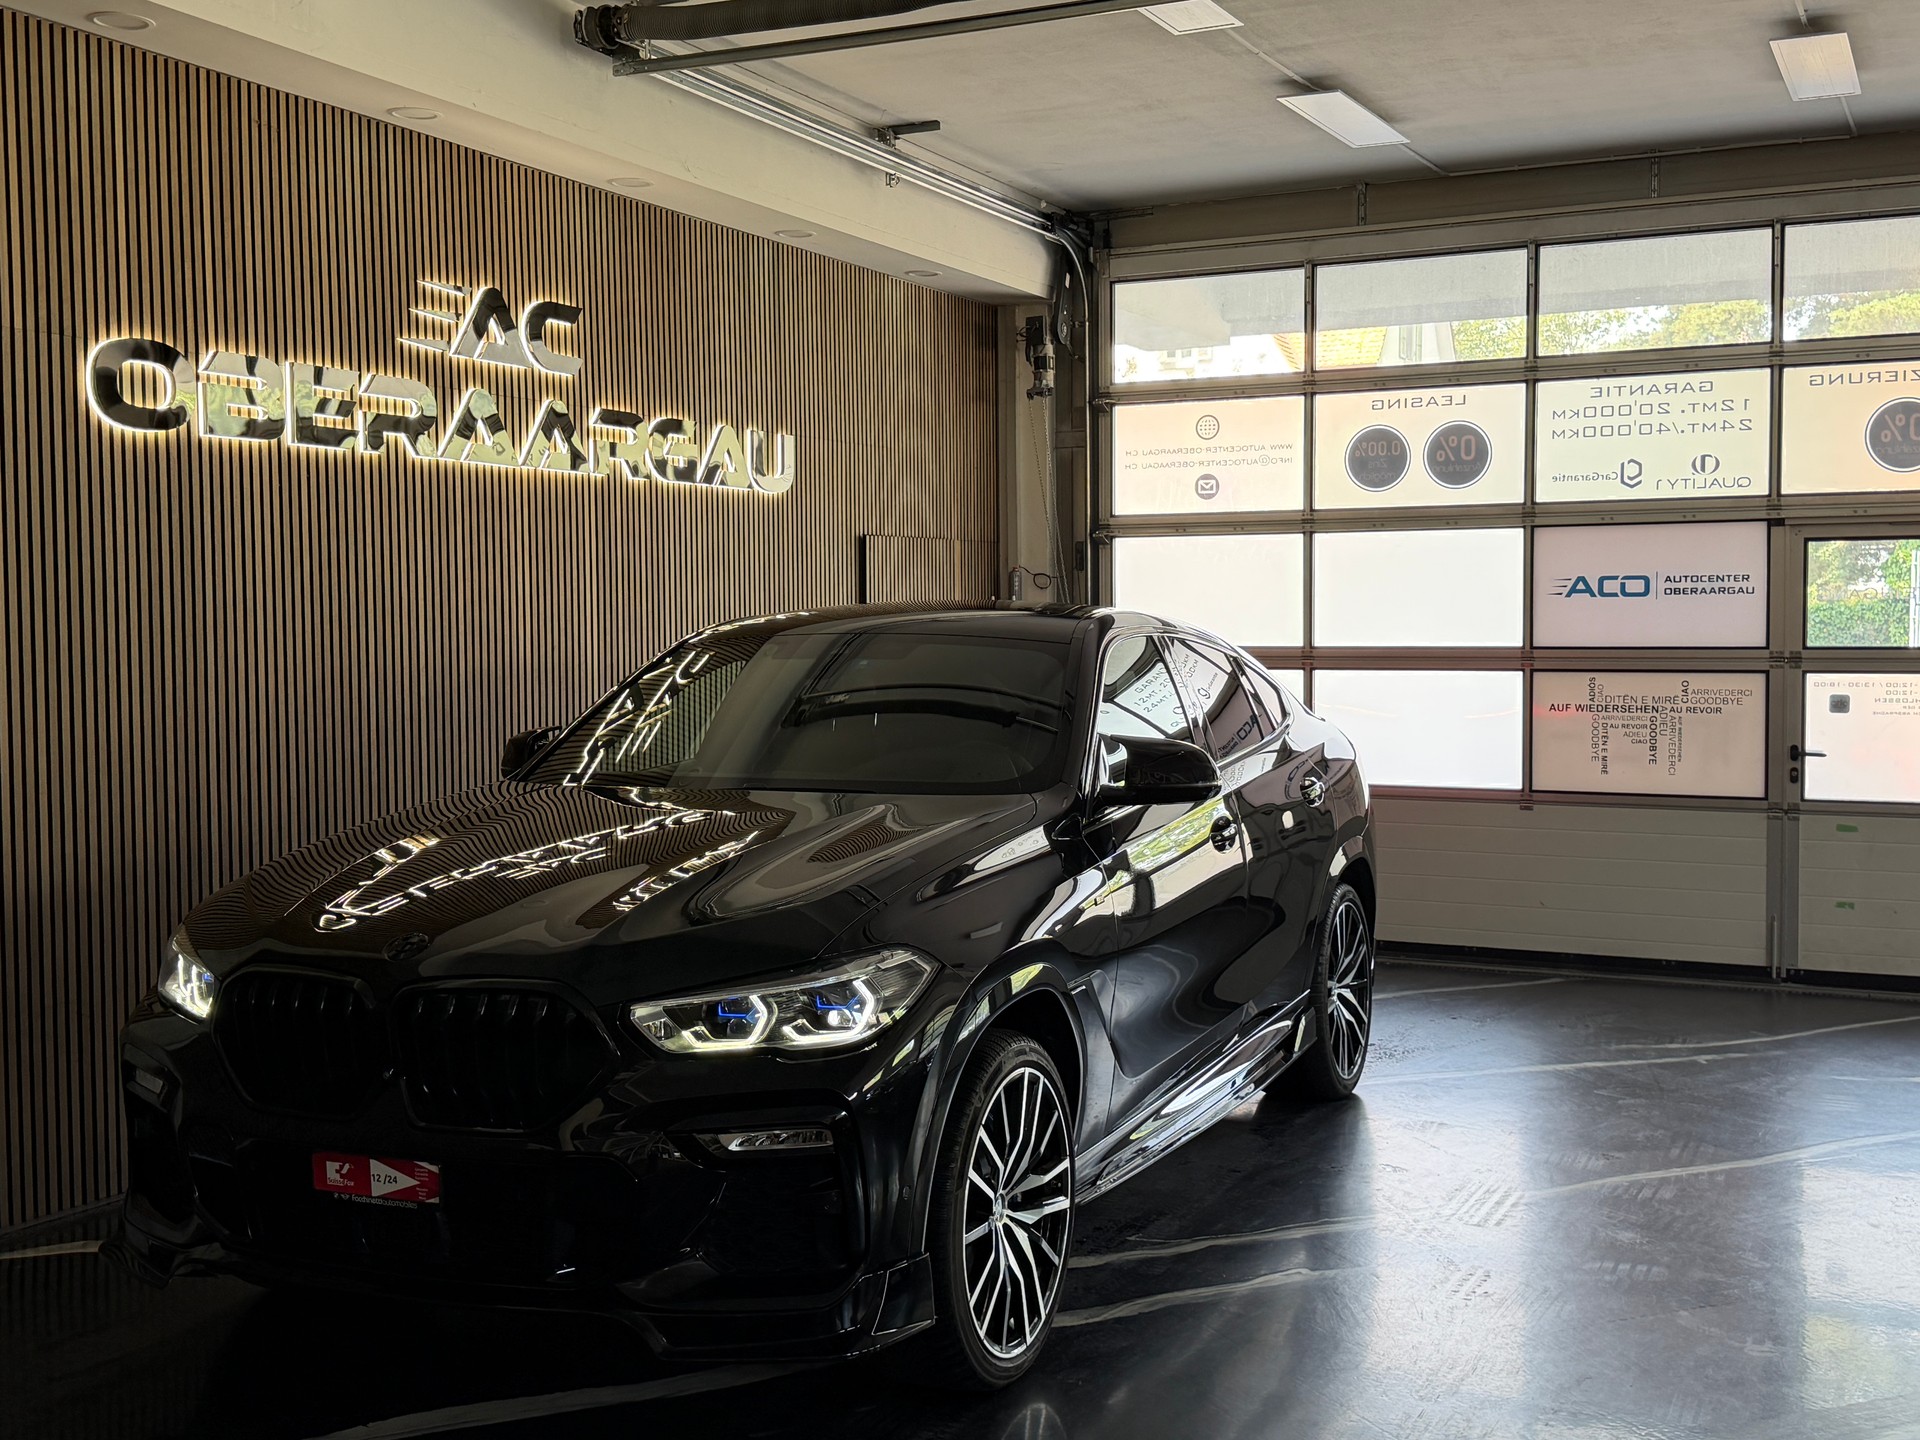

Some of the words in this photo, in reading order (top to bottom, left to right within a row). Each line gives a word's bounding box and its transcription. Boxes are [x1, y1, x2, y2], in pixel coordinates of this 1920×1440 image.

[85, 337, 795, 495] OBERAARGAU
[1663, 573, 1750, 584] AUTOCENTER
[1564, 575, 1650, 598] ACO
[1663, 586, 1755, 596] OBERAARGAU
[1681, 680, 1690, 704] CIAO
[1690, 688, 1753, 697] ARRIVEDERCI
[1690, 697, 1744, 706] GOODBYE
[1549, 703, 1571, 712] AUF
[1574, 703, 1660, 714] WIEDERSEHEN
[1668, 706, 1683, 714] AU
[1685, 706, 1723, 715] REVOIR
[1600, 714, 1648, 722] ARRIVEDERCI
[1659, 705, 1668, 737] ADIEU
[1591, 713, 1600, 762] GOODBYE
[1623, 730, 1648, 738] ADIEU
[1648, 715, 1658, 766] GOODBYE
[1668, 714, 1677, 776] ARRIVEDERCI
